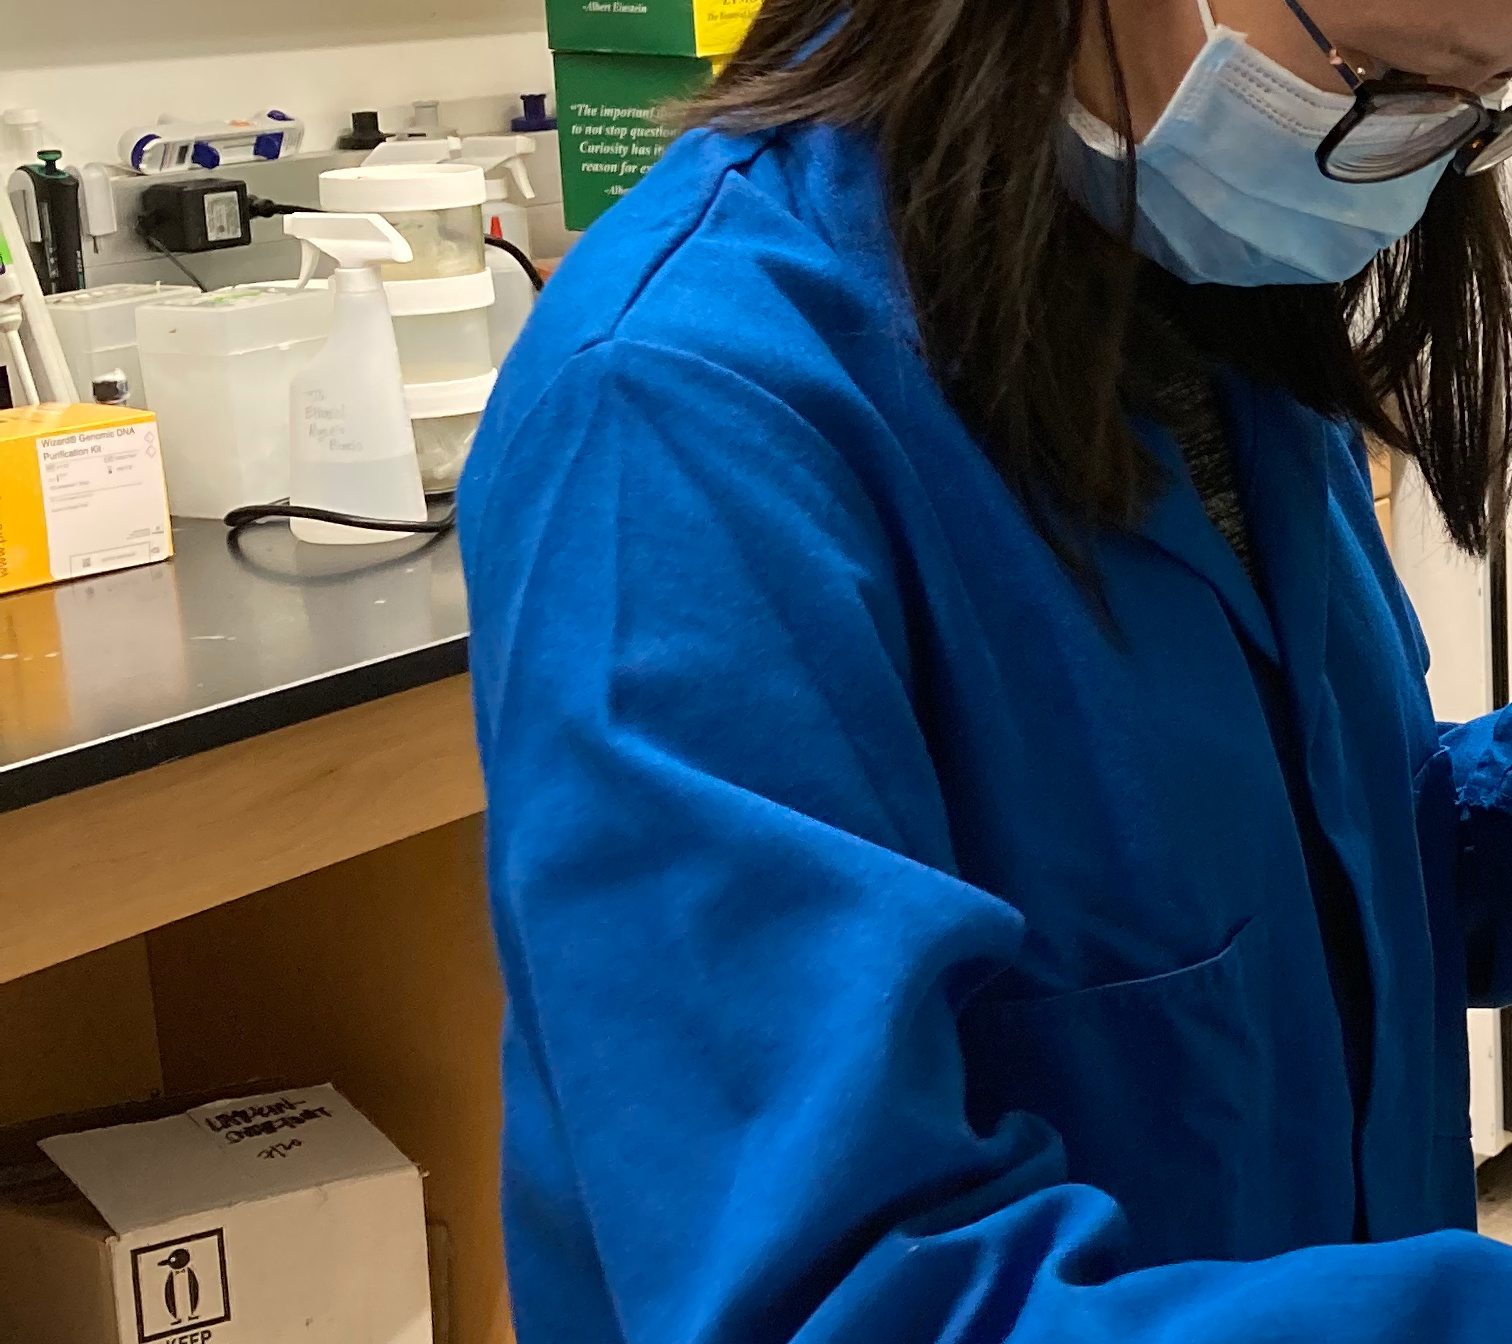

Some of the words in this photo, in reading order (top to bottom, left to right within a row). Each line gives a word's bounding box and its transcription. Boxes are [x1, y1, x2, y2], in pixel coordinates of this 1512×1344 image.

[613, 3, 648, 14] Einstein
[571, 124, 582, 136] to
[584, 124, 602, 136] not
[604, 125, 628, 140] stop
[579, 141, 628, 156] Curiosity
[630, 143, 651, 156] has
[581, 162, 616, 173] reason
[618, 160, 637, 176] for
[78, 431, 115, 443] Genomic
[116, 426, 136, 438] DNA
[42, 447, 89, 461] Purification
[90, 444, 102, 454] Kit
